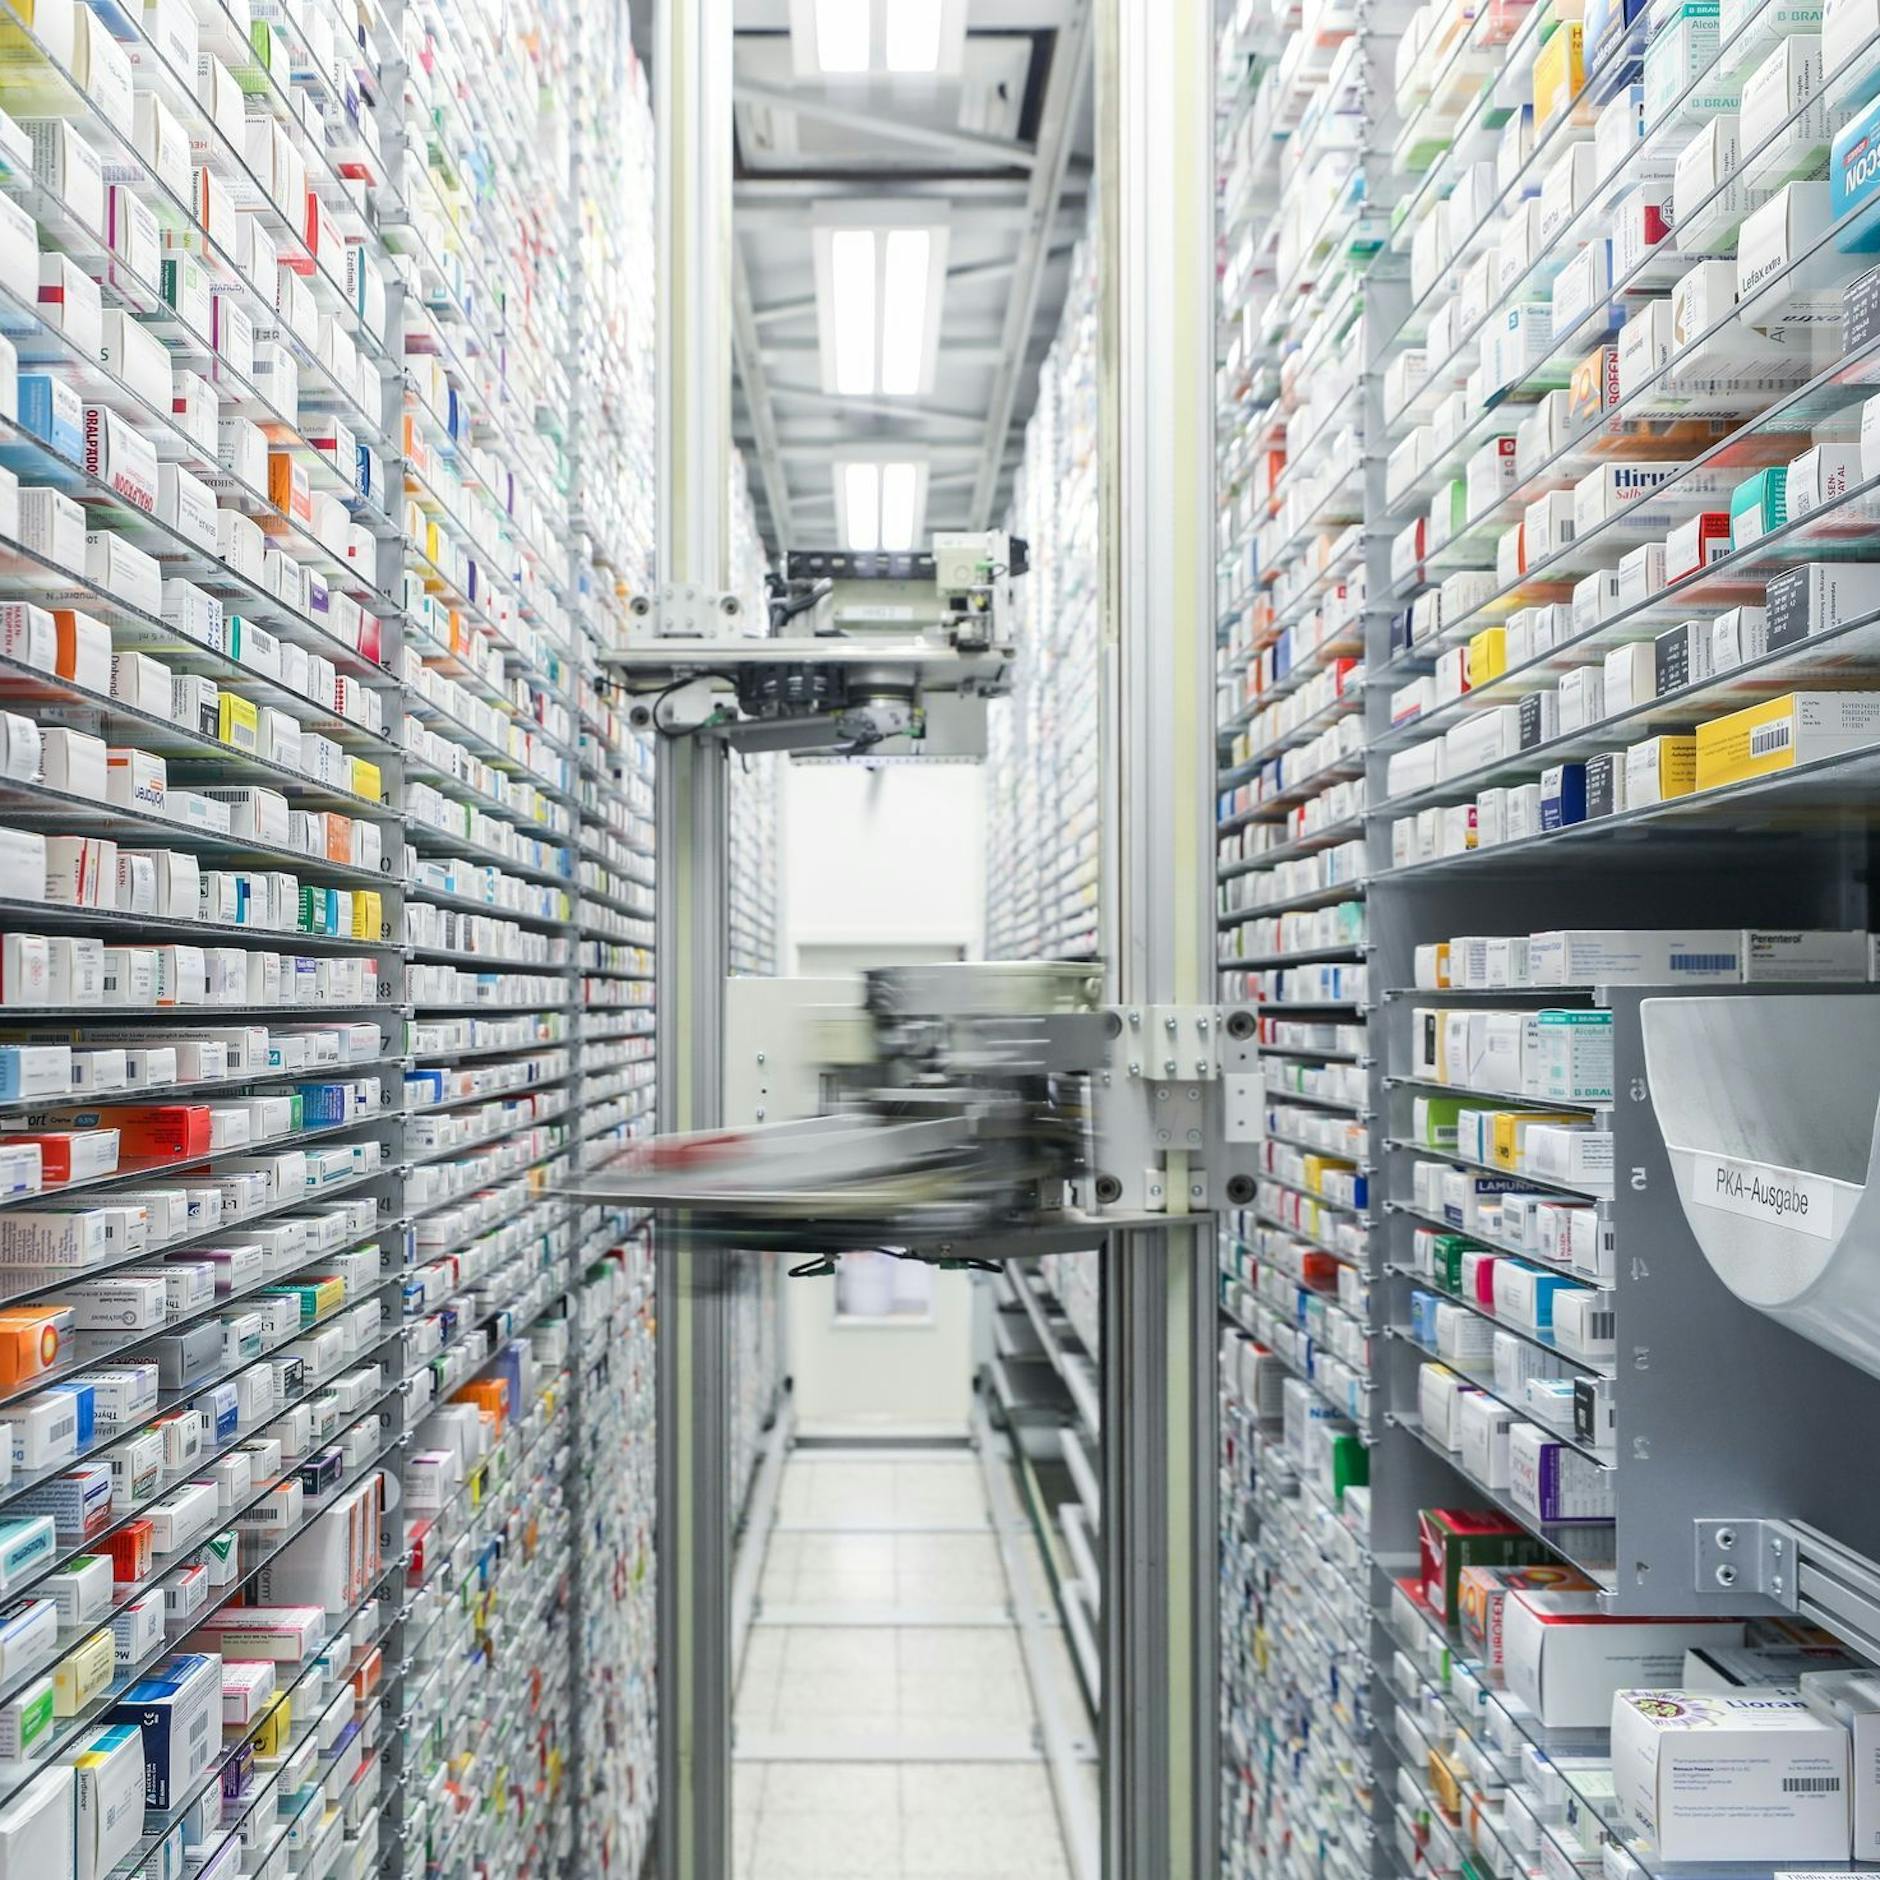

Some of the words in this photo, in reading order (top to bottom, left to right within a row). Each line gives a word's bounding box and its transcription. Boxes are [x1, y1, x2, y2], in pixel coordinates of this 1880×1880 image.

[1696, 6, 1720, 14] BRAU
[1691, 20, 1720, 29] Alcoh
[1742, 266, 1765, 293] Lefax
[1765, 255, 1782, 276] extra
[86, 409, 99, 475] ORALPÄDO
[1615, 487, 1644, 500] Salb
[381, 726, 391, 738] 2
[134, 784, 165, 810] Voltaren
[381, 791, 390, 804] 1
[380, 857, 391, 873] 0
[381, 922, 391, 938] 9
[1751, 933, 1802, 945] Perenterol
[379, 982, 391, 997] 8
[380, 1036, 391, 1051] 7
[380, 1090, 391, 1105] 6
[50, 1116, 72, 1125] Creme
[380, 1143, 391, 1158] 5
[1716, 1167, 1809, 1215] PKA-Ausgabe
[380, 1250, 391, 1266] 3
[380, 1305, 391, 1320] 2
[380, 1412, 391, 1428] 0
[1494, 1596, 1504, 1664] NUROFEN
